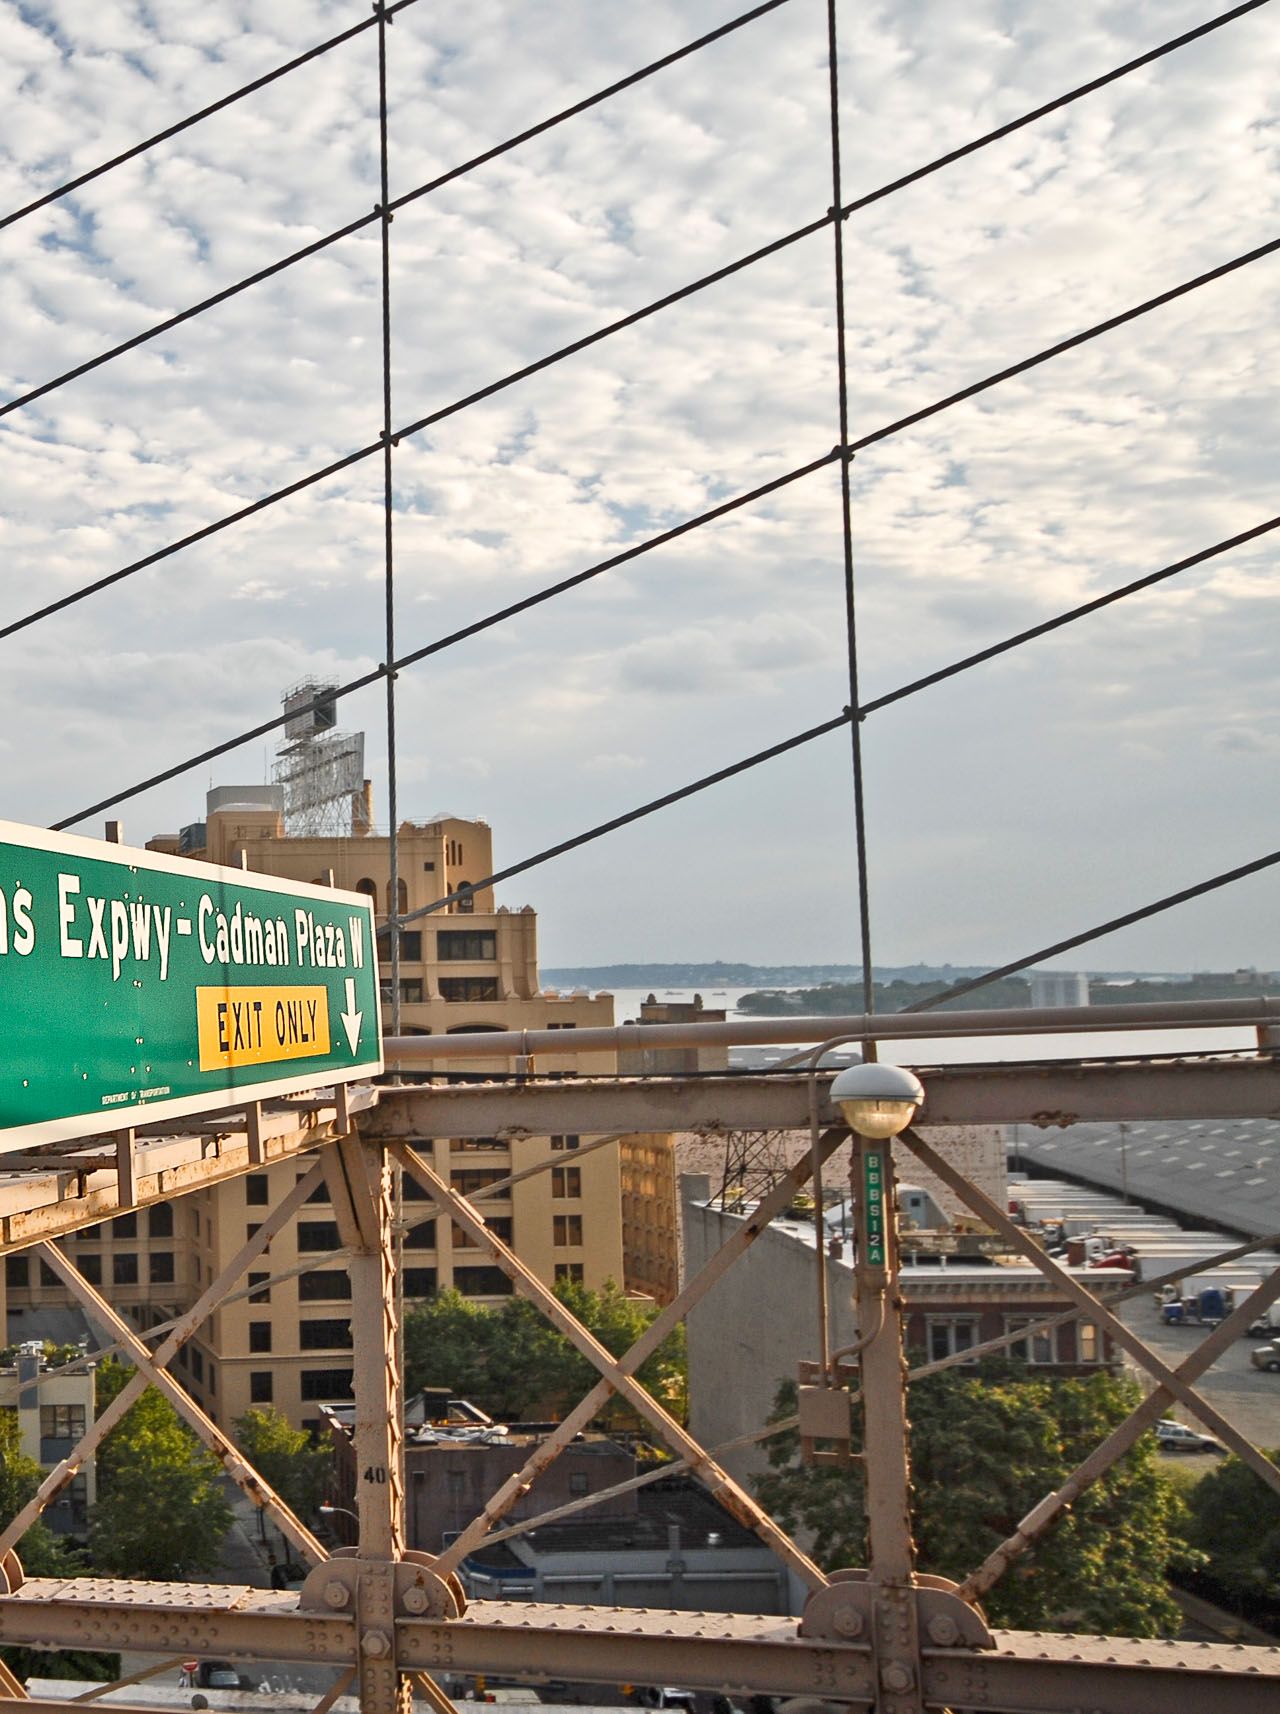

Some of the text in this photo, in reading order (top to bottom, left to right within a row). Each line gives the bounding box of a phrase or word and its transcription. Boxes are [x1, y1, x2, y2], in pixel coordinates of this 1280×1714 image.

[294, 908, 347, 970] Plaza
[347, 916, 364, 969] W
[217, 998, 318, 1053] EXIT ONLY
[363, 1466, 386, 1484] 40
